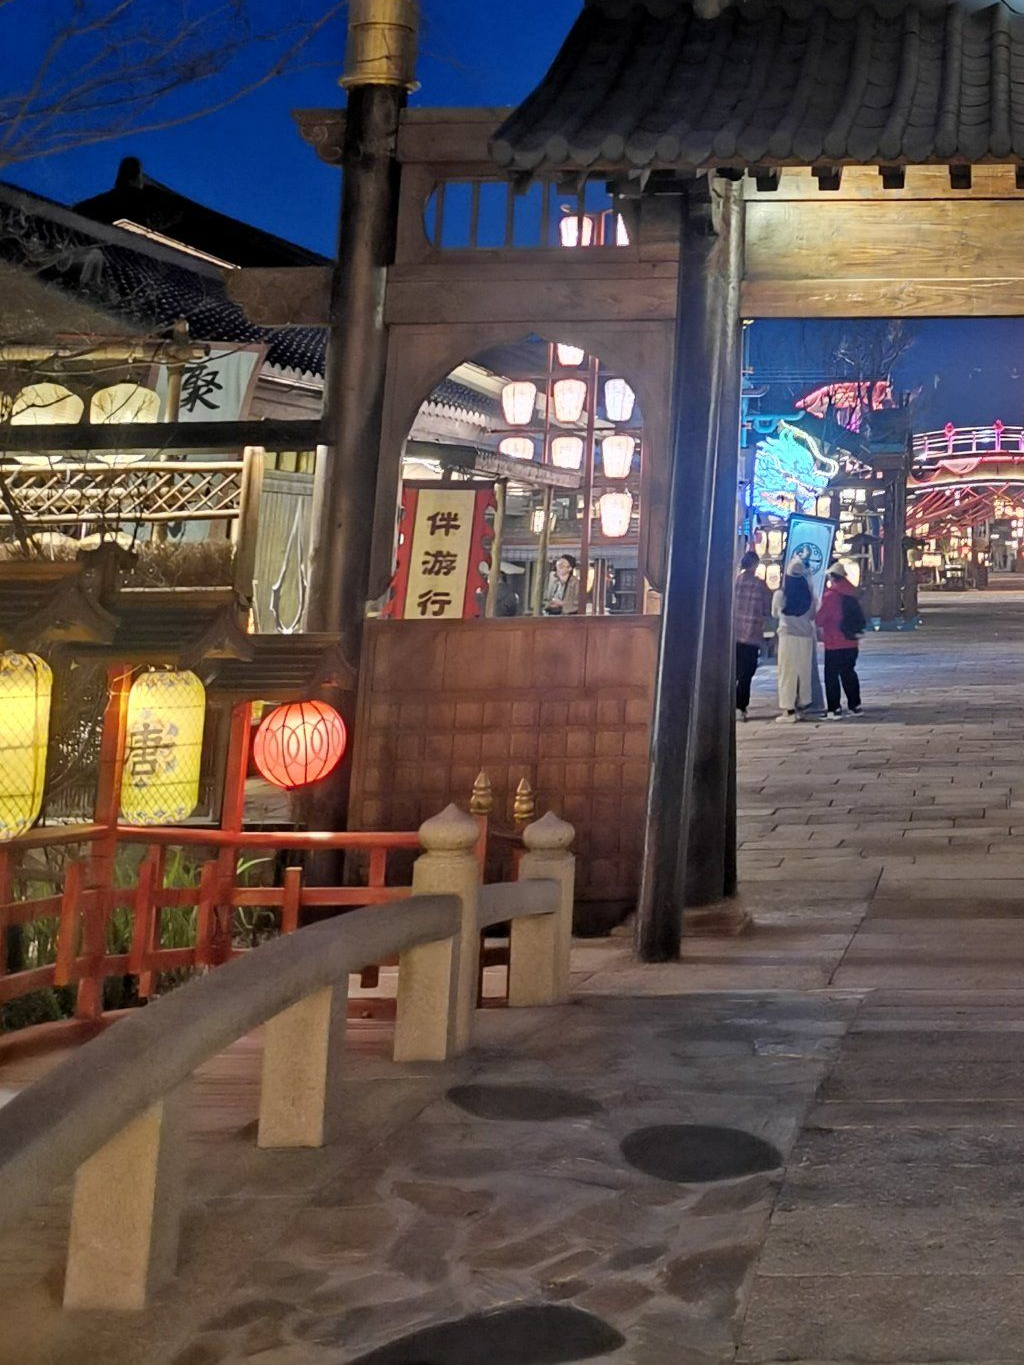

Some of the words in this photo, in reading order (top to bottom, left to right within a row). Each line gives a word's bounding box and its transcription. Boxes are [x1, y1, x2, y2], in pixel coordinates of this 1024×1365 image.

[180, 364, 223, 413] 聚
[416, 511, 461, 617] 伴游行
[123, 722, 176, 777] 唐
